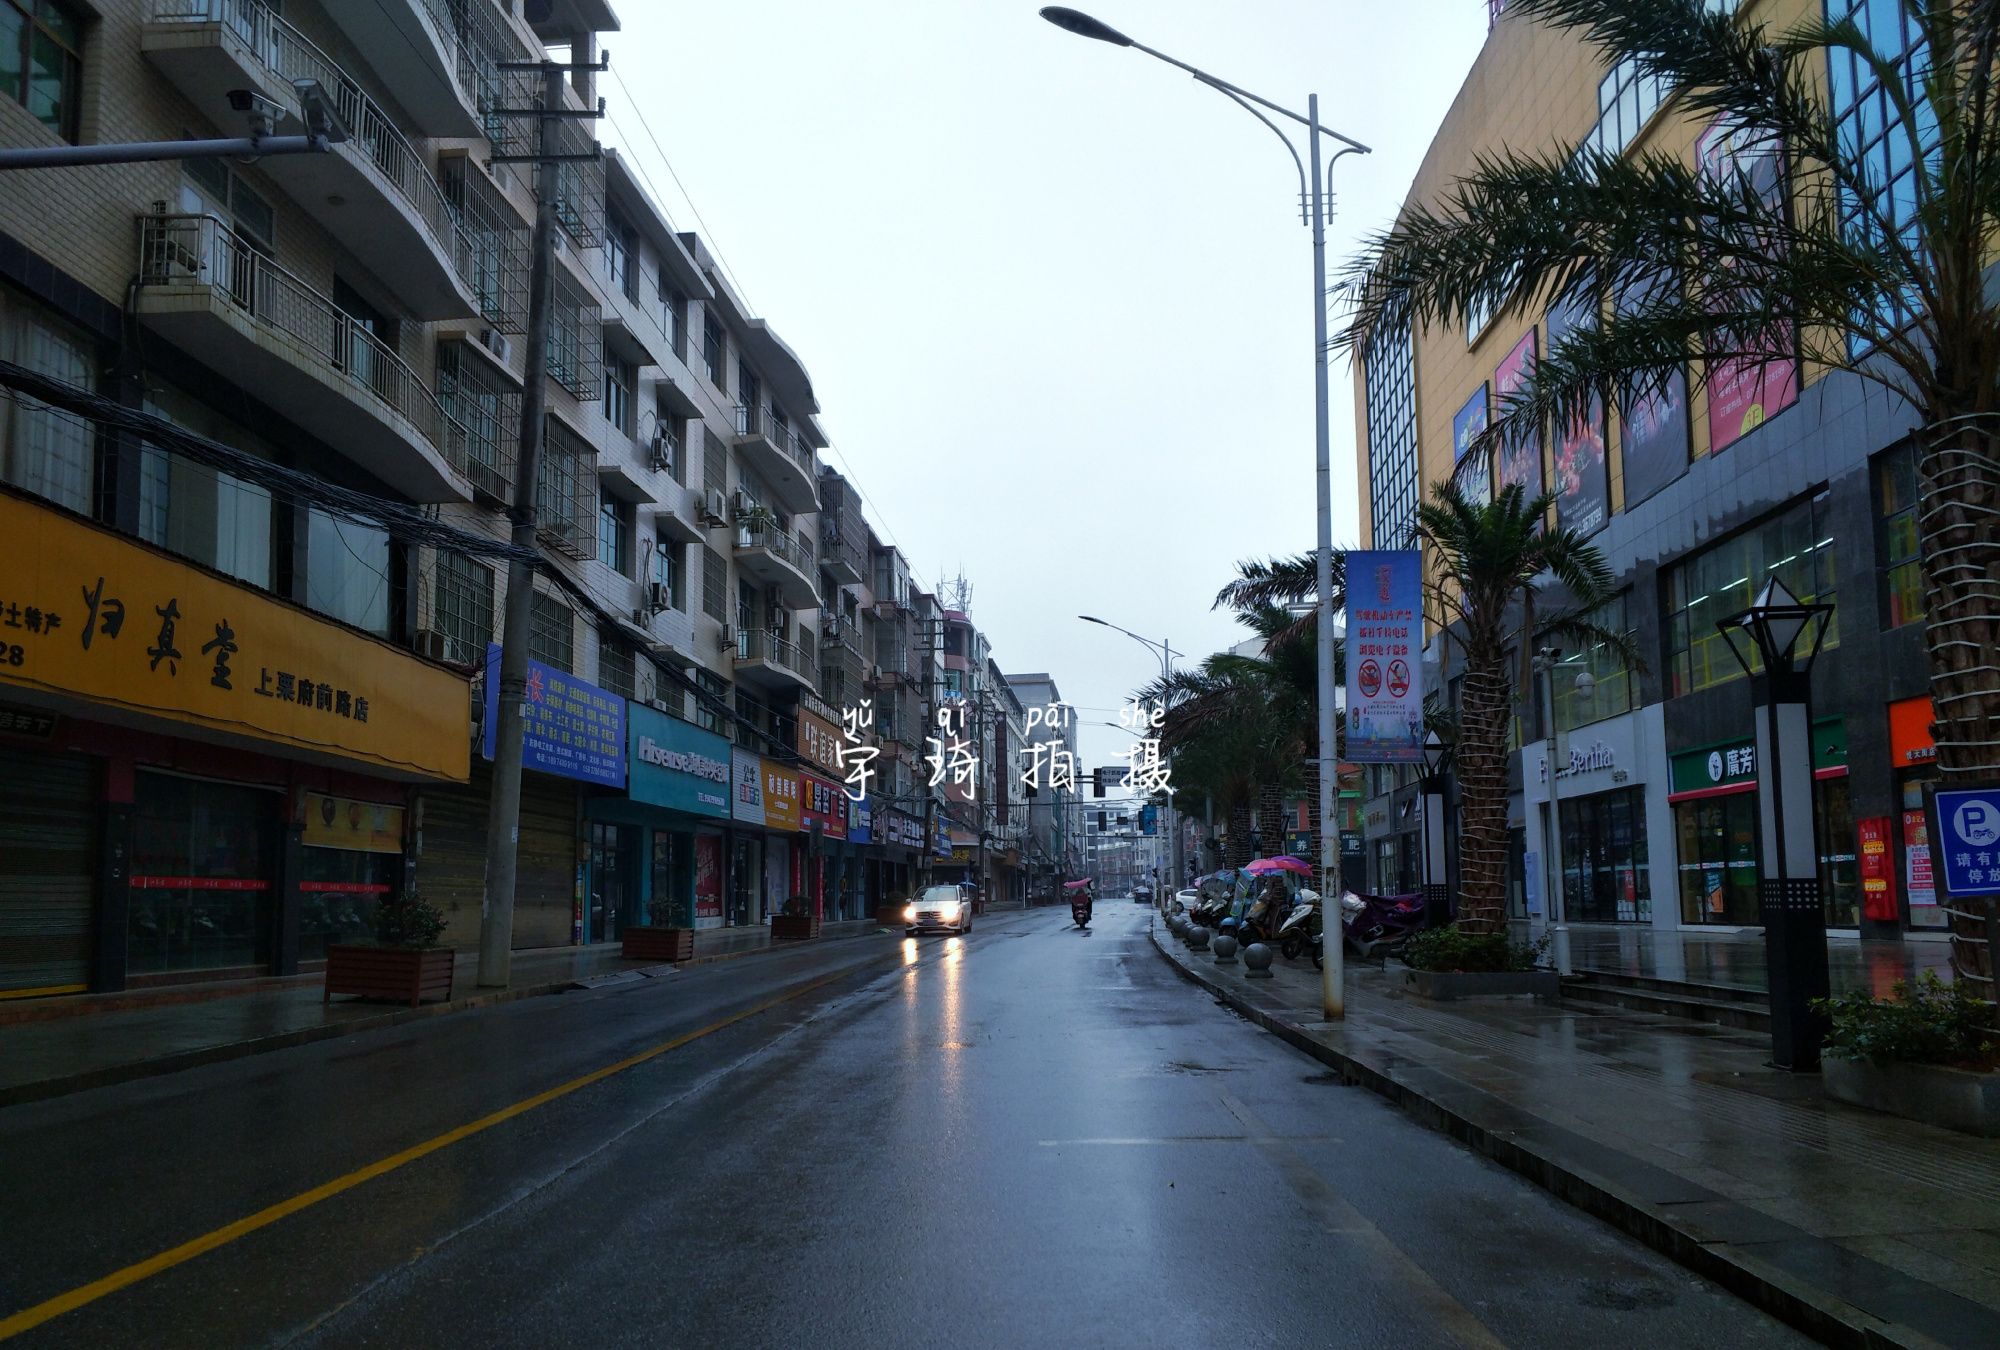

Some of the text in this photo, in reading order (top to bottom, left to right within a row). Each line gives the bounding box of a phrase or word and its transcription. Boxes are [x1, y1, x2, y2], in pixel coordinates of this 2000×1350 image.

[82, 577, 238, 690] 归真堂
[254, 668, 369, 723] 上栗府前路店
[1727, 746, 1758, 777] 廣芳
[1962, 807, 1986, 838] P
[1956, 851, 2000, 867] 请有
